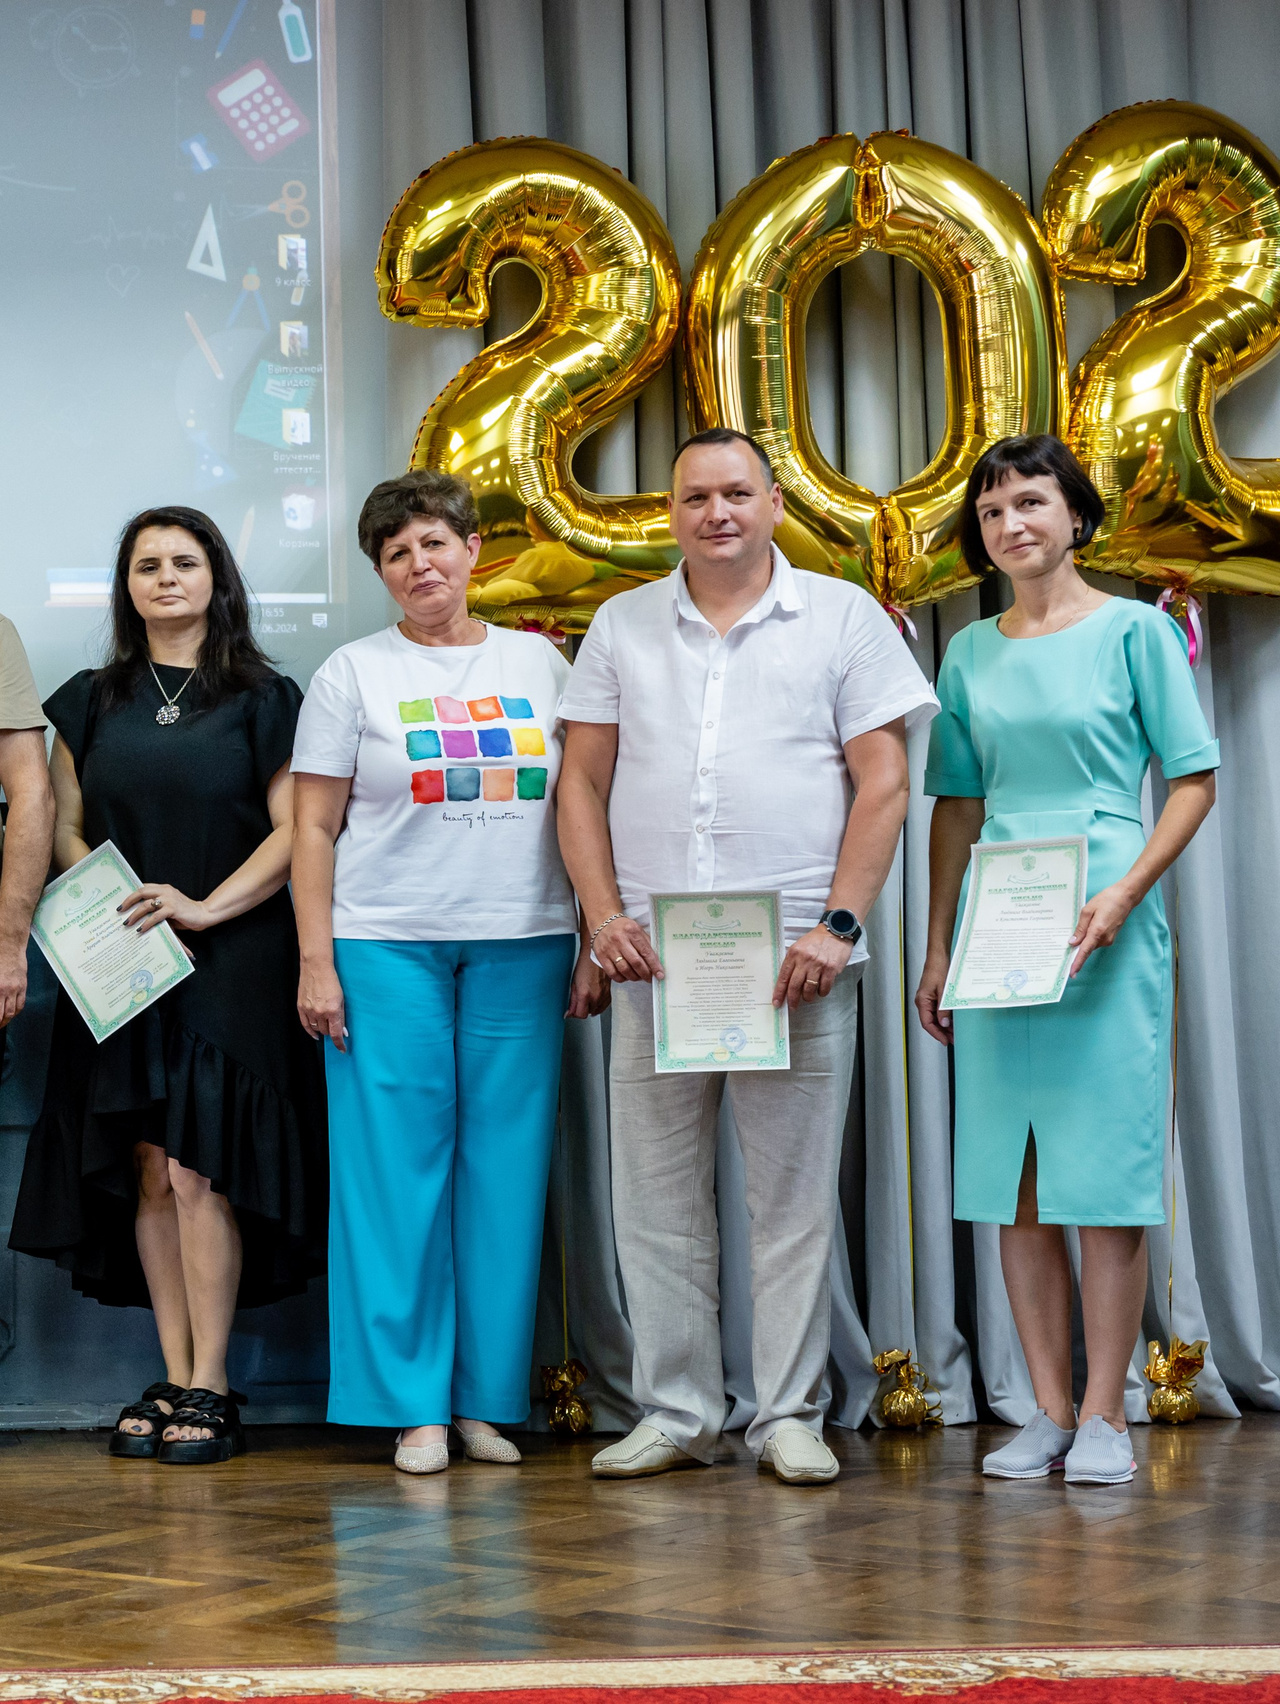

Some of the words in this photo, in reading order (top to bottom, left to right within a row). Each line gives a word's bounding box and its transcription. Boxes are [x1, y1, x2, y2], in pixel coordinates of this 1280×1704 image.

[283, 279, 312, 287] класс
[267, 364, 323, 376] Выпускной
[273, 451, 321, 463] Вручение
[278, 539, 320, 549] Корзина
[261, 607, 285, 617] 16:55
[442, 812, 473, 828] beauty
[477, 811, 485, 827] of
[489, 812, 524, 820] emotions
